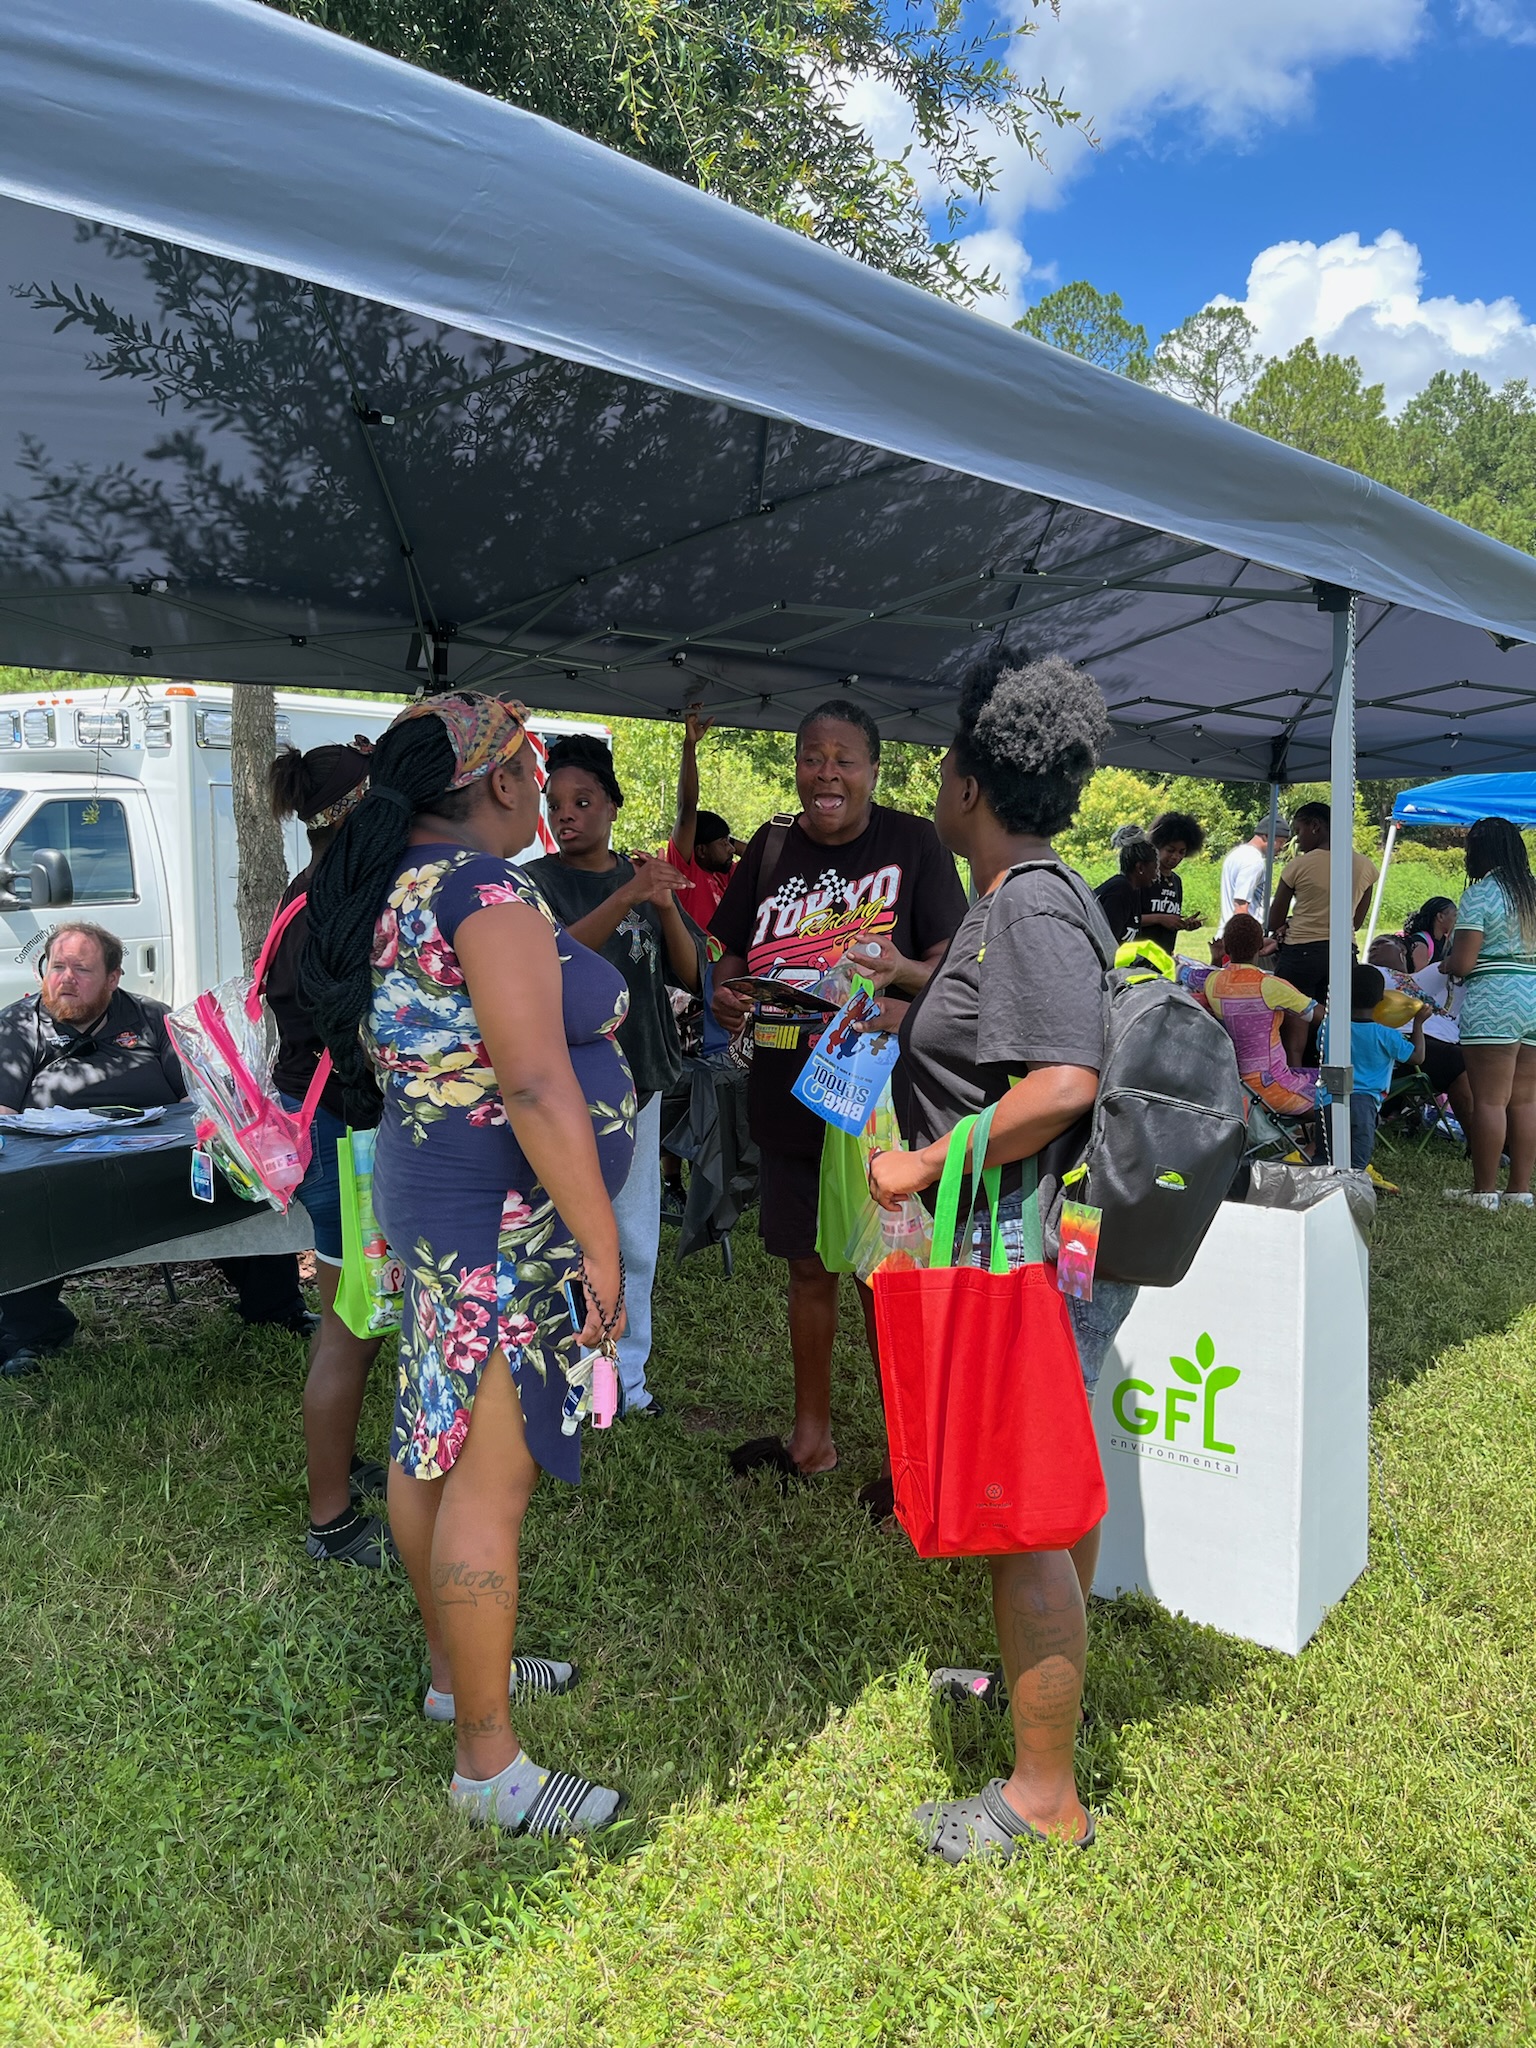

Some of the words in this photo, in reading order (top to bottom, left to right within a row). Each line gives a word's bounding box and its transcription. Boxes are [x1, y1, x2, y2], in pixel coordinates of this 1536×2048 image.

[751, 864, 903, 948] TOKYO
[796, 896, 887, 939] Racing
[14, 928, 50, 965] Community
[1112, 1366, 1242, 1455] GFL
[1110, 1438, 1239, 1474] environmental
